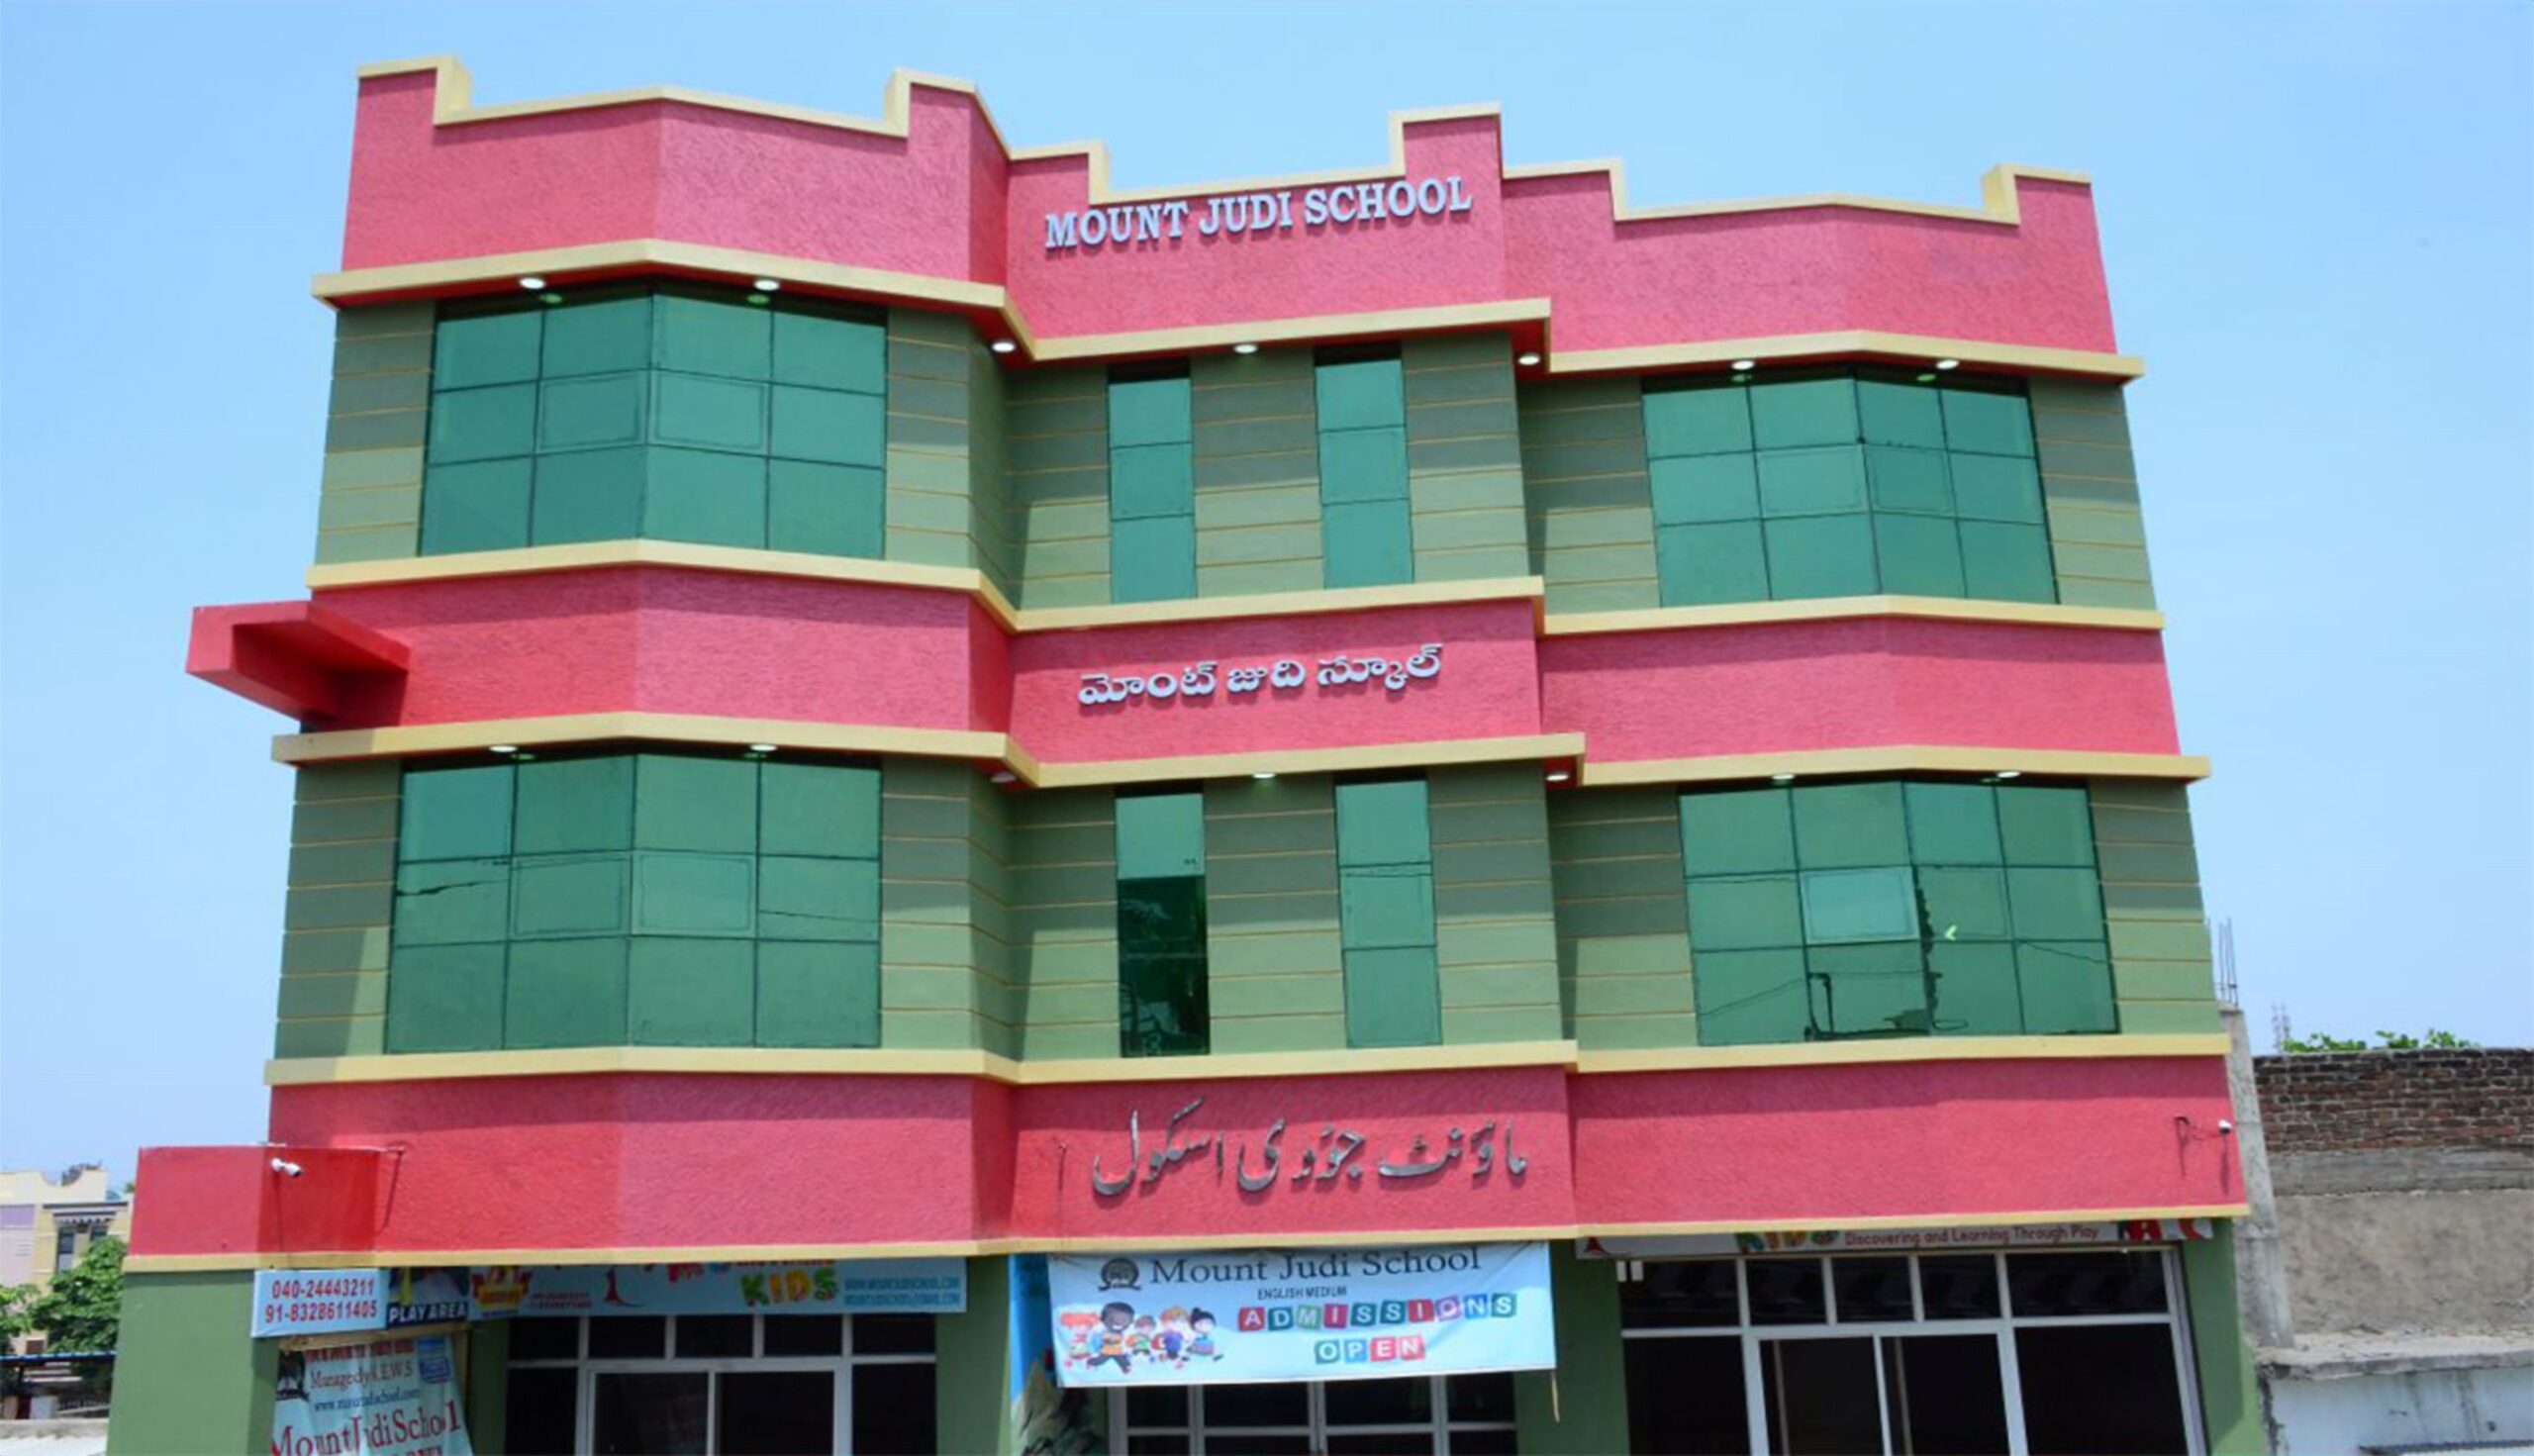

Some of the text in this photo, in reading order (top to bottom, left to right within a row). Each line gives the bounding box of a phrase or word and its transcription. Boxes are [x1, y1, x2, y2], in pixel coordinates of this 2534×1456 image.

[1044, 175, 1473, 248] MOUNT JUDI SCHOOL
[1844, 1229, 1919, 1247] Discovering
[1924, 1227, 1947, 1243] and
[1951, 1226, 2009, 1246] Learning
[2012, 1224, 2067, 1244] Through
[2071, 1222, 2098, 1241] Play
[1149, 1246, 1480, 1285] Mount Judi School
[271, 1278, 375, 1299] 040-24443211
[739, 1267, 838, 1307] KIDS
[1257, 1285, 1347, 1301] ENGLISH MEDIUM
[264, 1300, 378, 1323] 91-8328611405
[388, 1304, 427, 1323] PLAY
[428, 1302, 466, 1320] AREA
[1241, 1295, 1515, 1328] ADMISSIONS
[1318, 1336, 1423, 1362] OPEN
